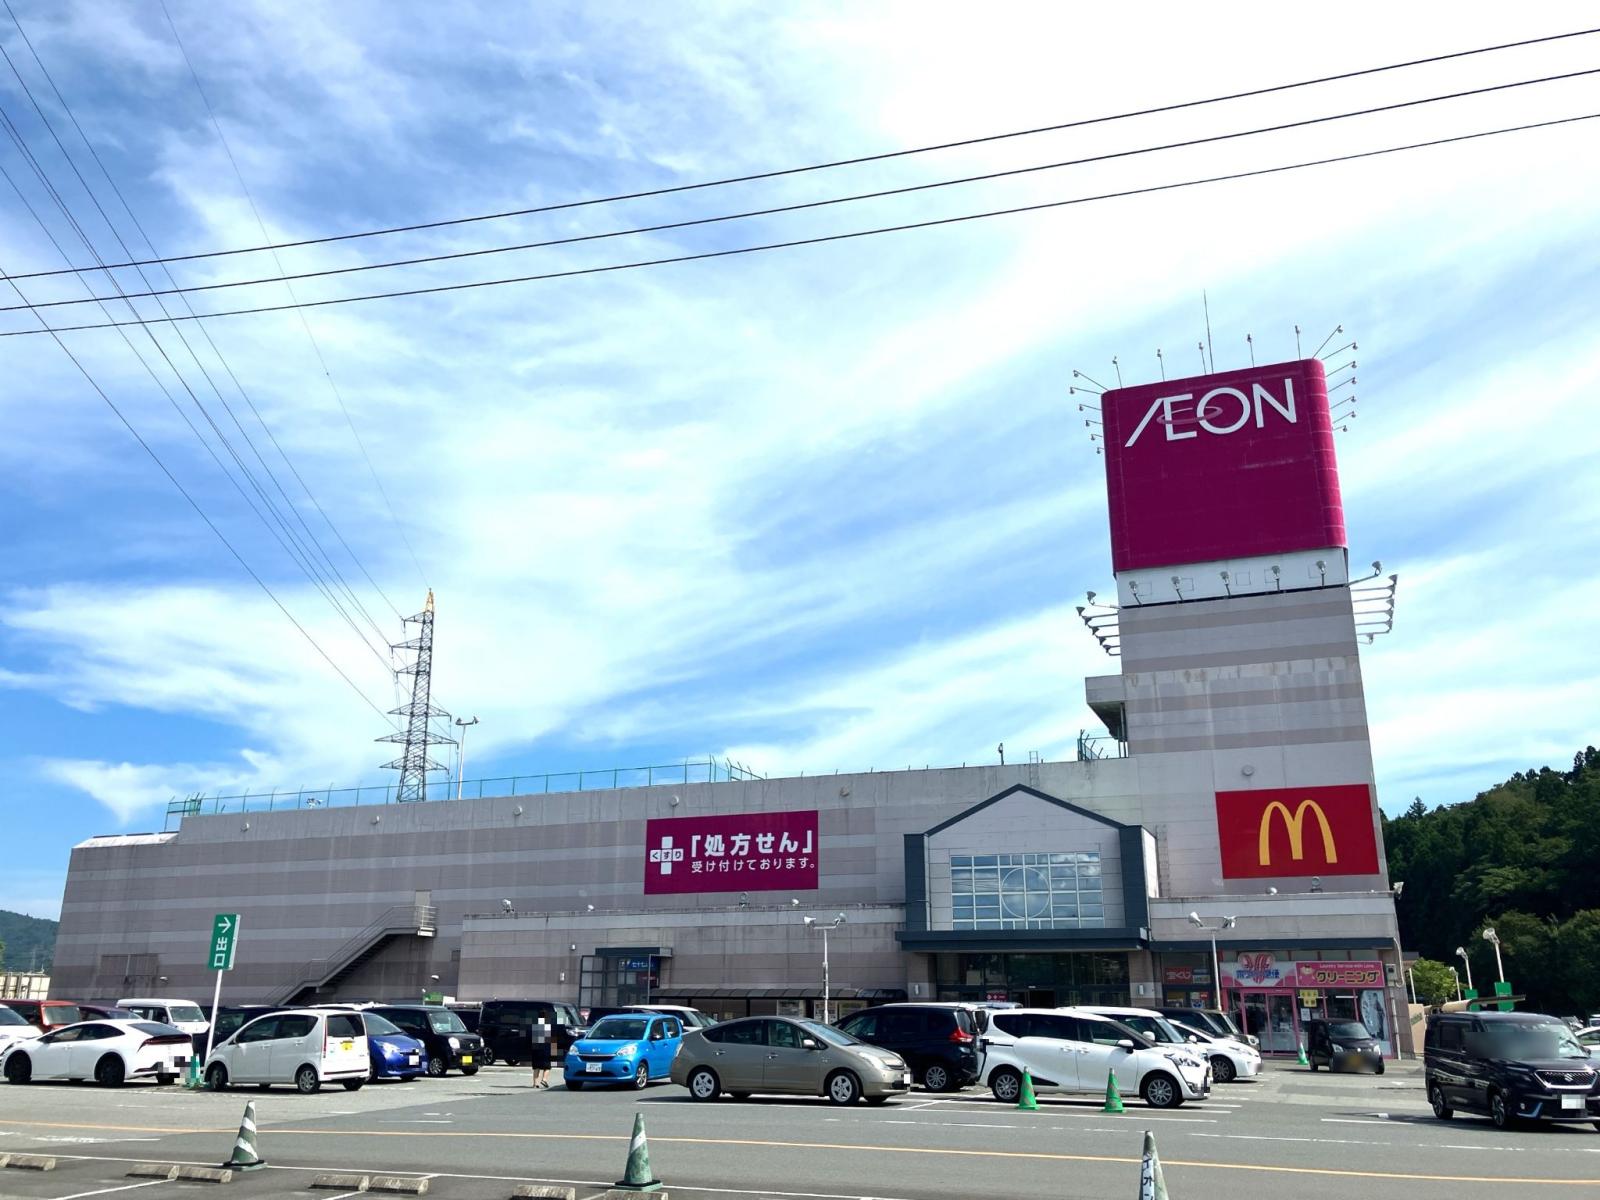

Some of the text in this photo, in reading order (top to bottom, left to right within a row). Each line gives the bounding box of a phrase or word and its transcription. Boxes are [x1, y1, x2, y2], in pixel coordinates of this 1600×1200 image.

[690, 829, 813, 858] 「処方せん」
[651, 850, 682, 861] くすり
[690, 857, 815, 874] 受け付けております。
[213, 936, 228, 967] 出口
[1317, 971, 1380, 984] クリーニング
